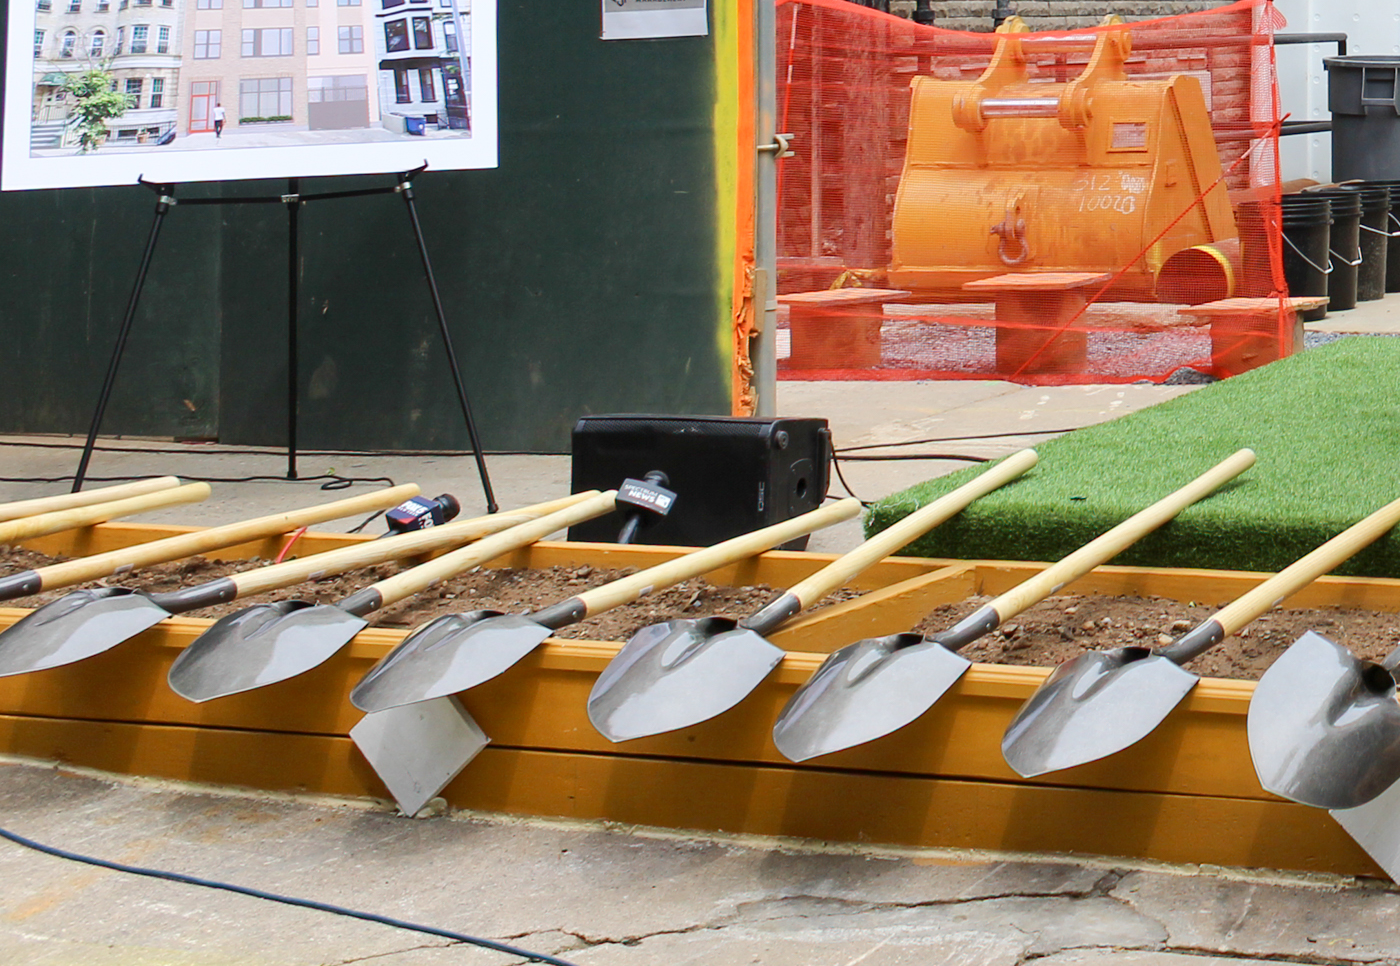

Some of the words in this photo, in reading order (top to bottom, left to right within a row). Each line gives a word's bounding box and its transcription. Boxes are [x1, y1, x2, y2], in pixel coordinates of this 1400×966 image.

[1072, 172, 1110, 191] 312
[624, 484, 658, 497] SPECTRUM
[628, 490, 655, 503] NEWS
